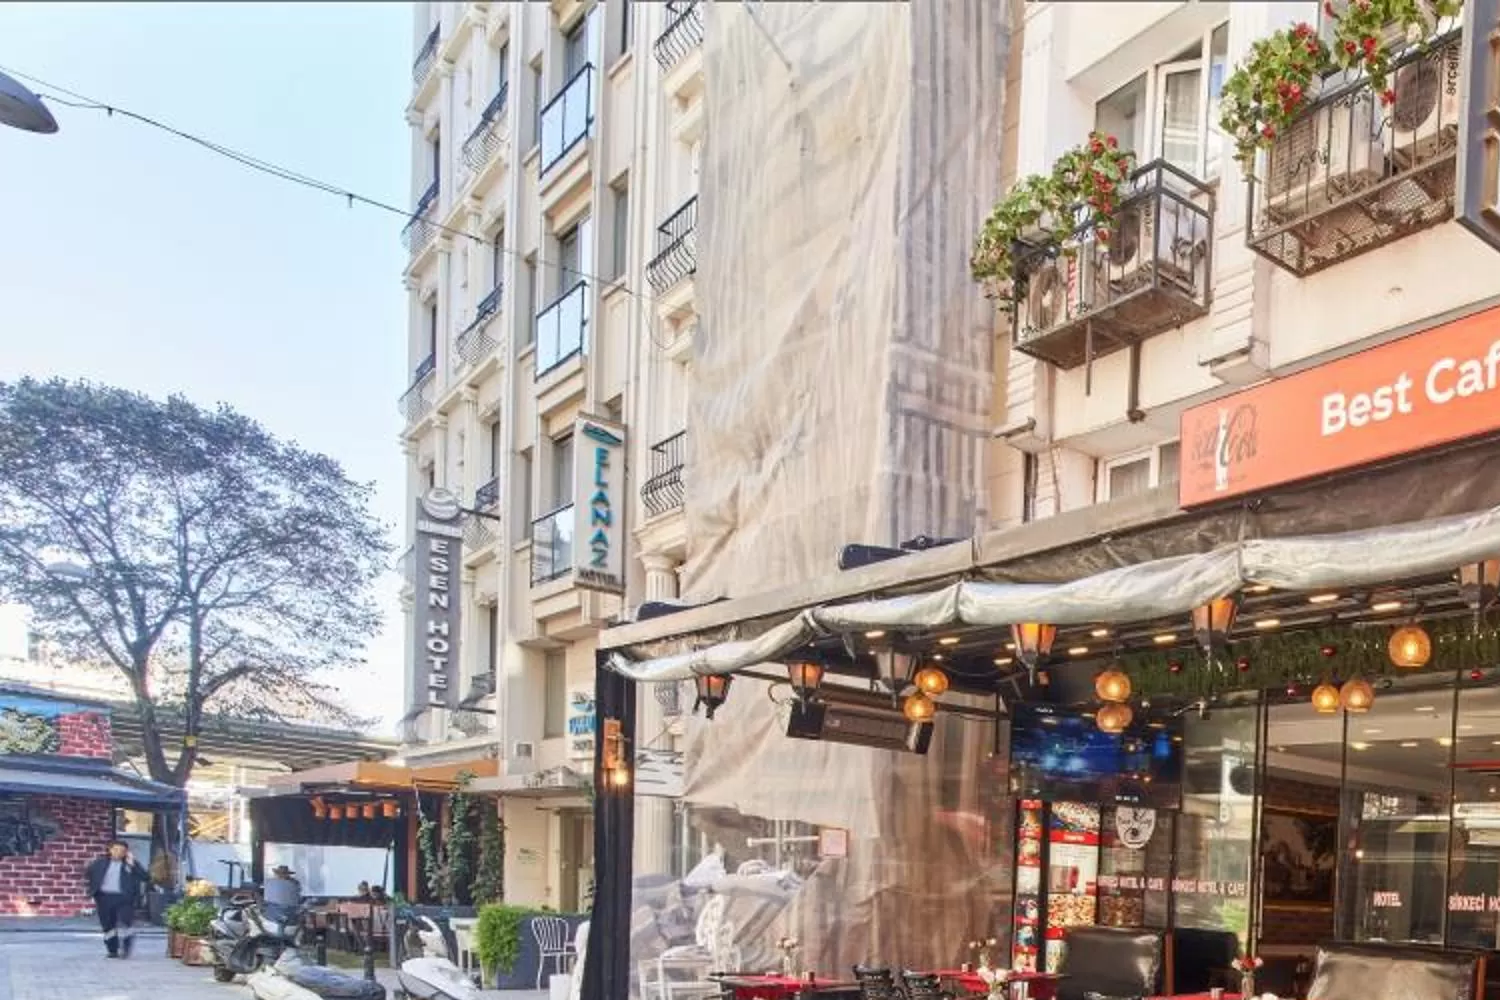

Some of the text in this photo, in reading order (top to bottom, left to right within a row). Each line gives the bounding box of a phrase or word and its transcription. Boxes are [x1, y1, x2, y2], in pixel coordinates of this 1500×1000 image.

[1321, 372, 1413, 436] Best
[589, 447, 612, 568] ELANAZ
[428, 537, 449, 609] ESEN
[426, 620, 449, 705] HOTEL
